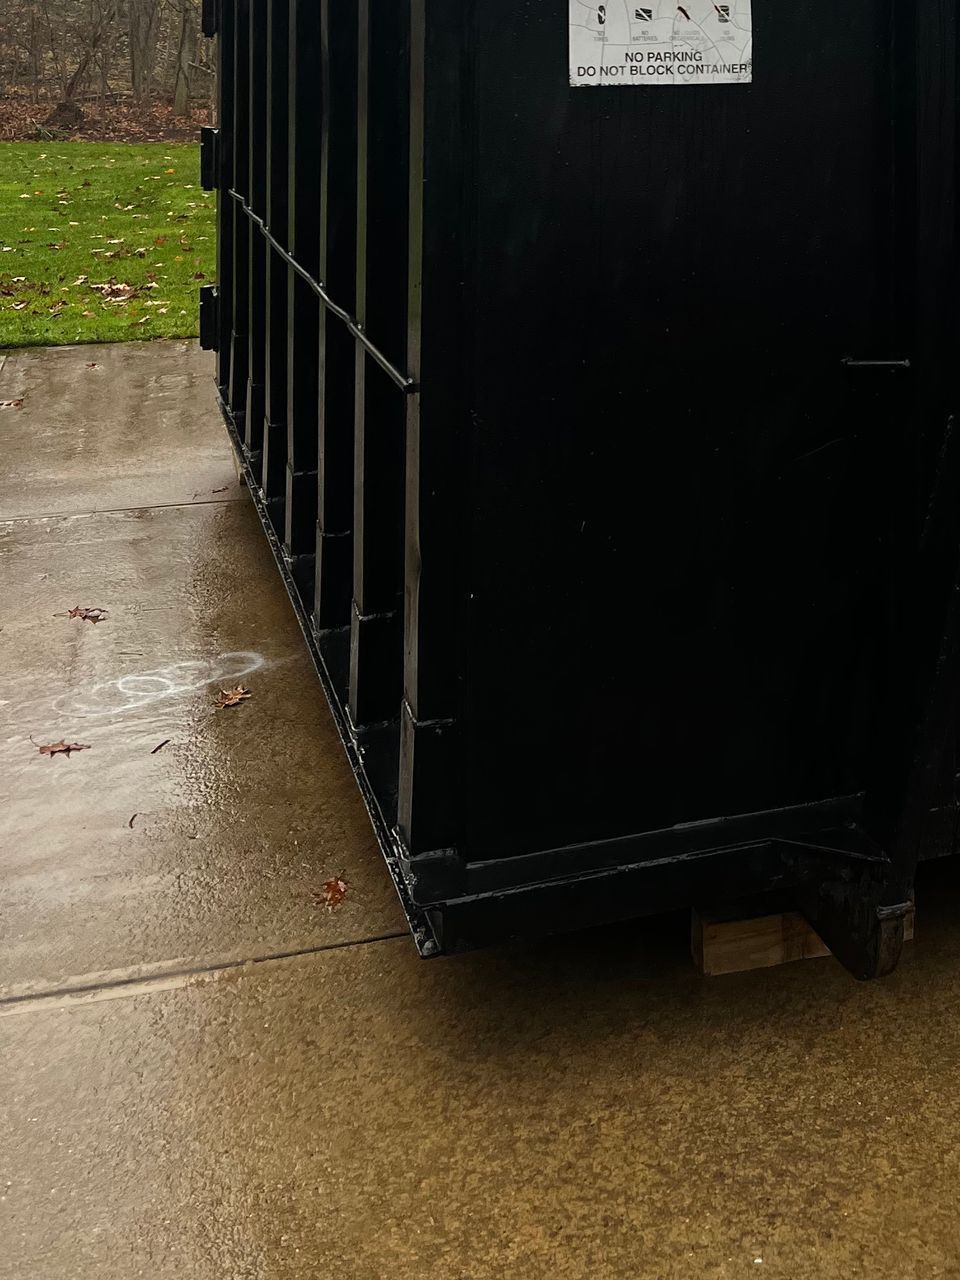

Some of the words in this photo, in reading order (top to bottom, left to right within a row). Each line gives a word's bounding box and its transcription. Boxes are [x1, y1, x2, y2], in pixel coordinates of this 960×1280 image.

[625, 52, 644, 63] NO
[647, 51, 703, 62] PARKING
[577, 66, 596, 77] DO
[599, 66, 627, 76] NOT
[630, 65, 674, 76] BLOCK
[678, 63, 748, 75] CONTAINER
